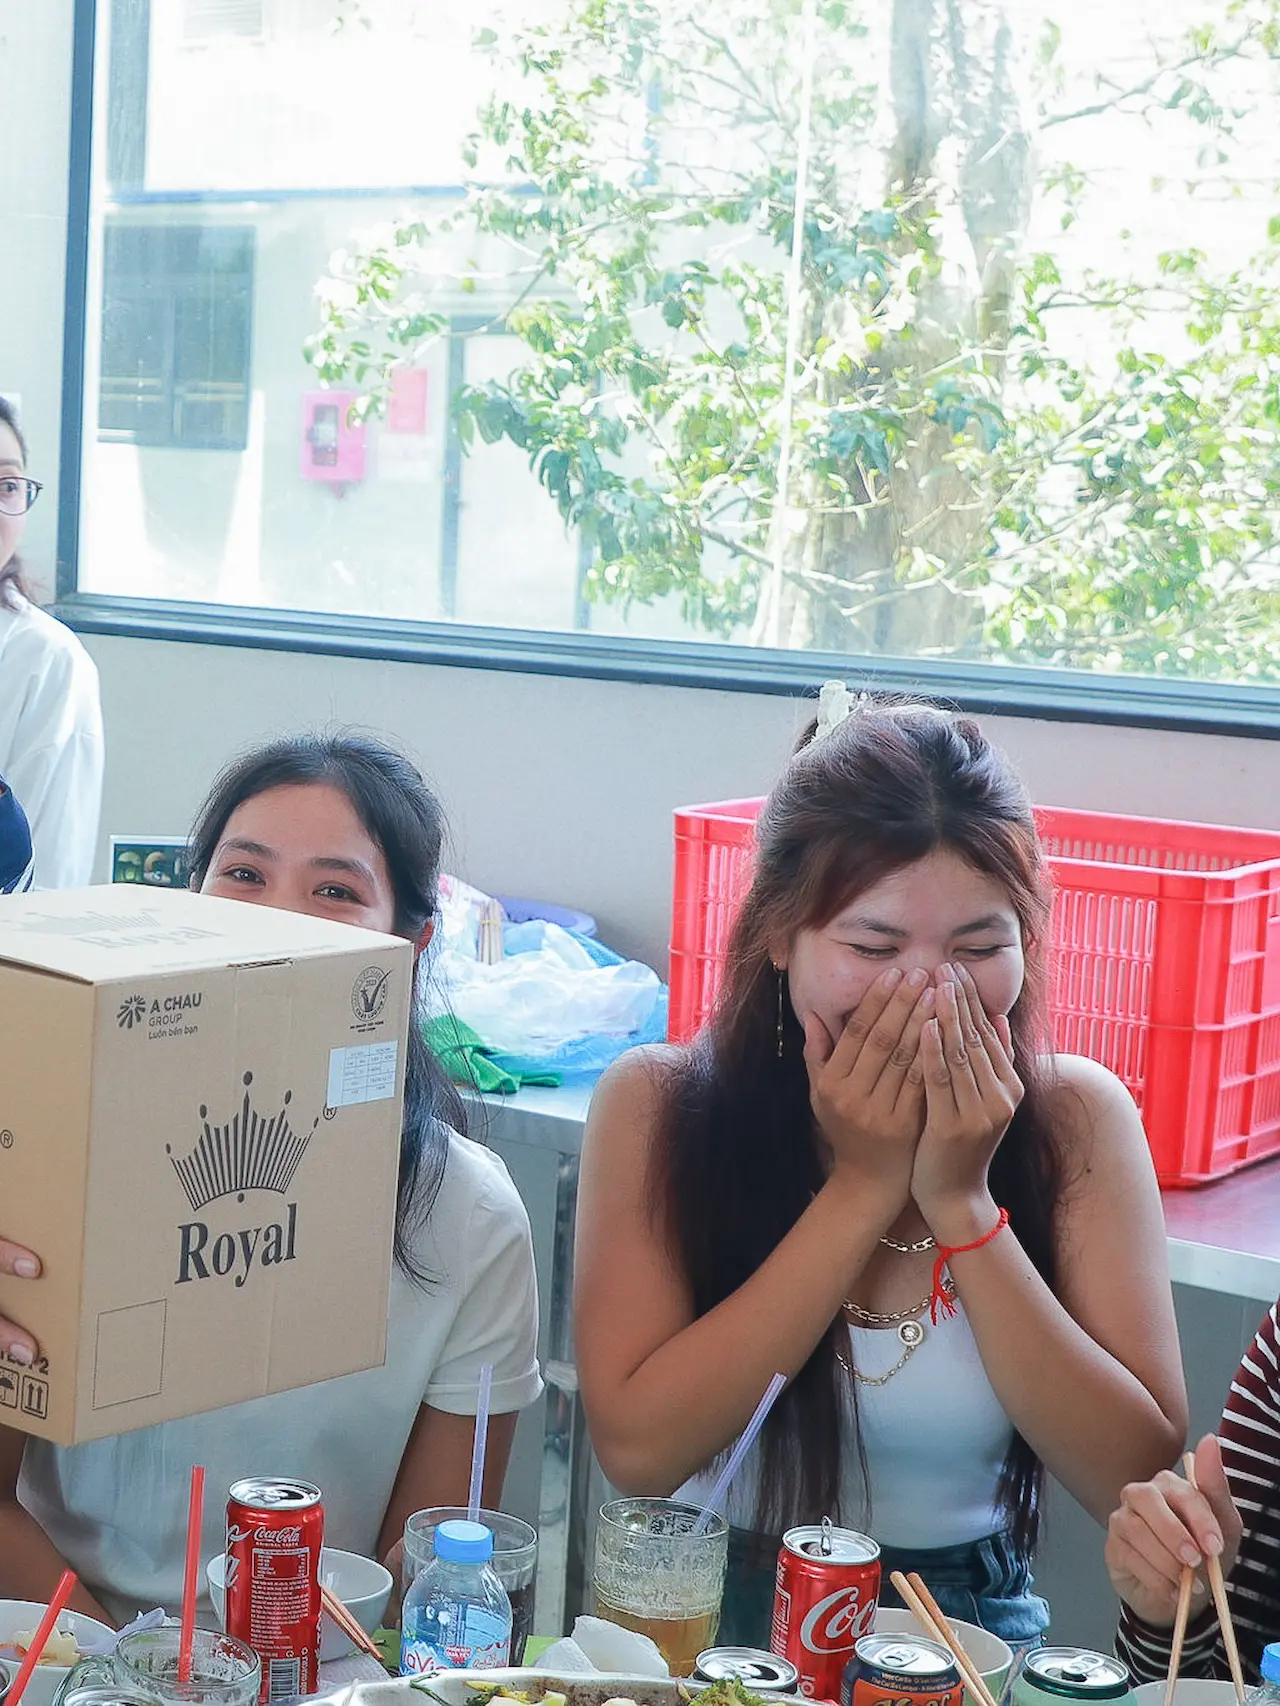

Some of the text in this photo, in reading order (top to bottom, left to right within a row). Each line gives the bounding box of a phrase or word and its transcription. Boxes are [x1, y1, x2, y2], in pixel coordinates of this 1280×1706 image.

[150, 992, 202, 1013] A CHAU
[148, 1012, 183, 1027] GROUP
[174, 1202, 298, 1288] Royal
[253, 1526, 302, 1543] Coca-Cola
